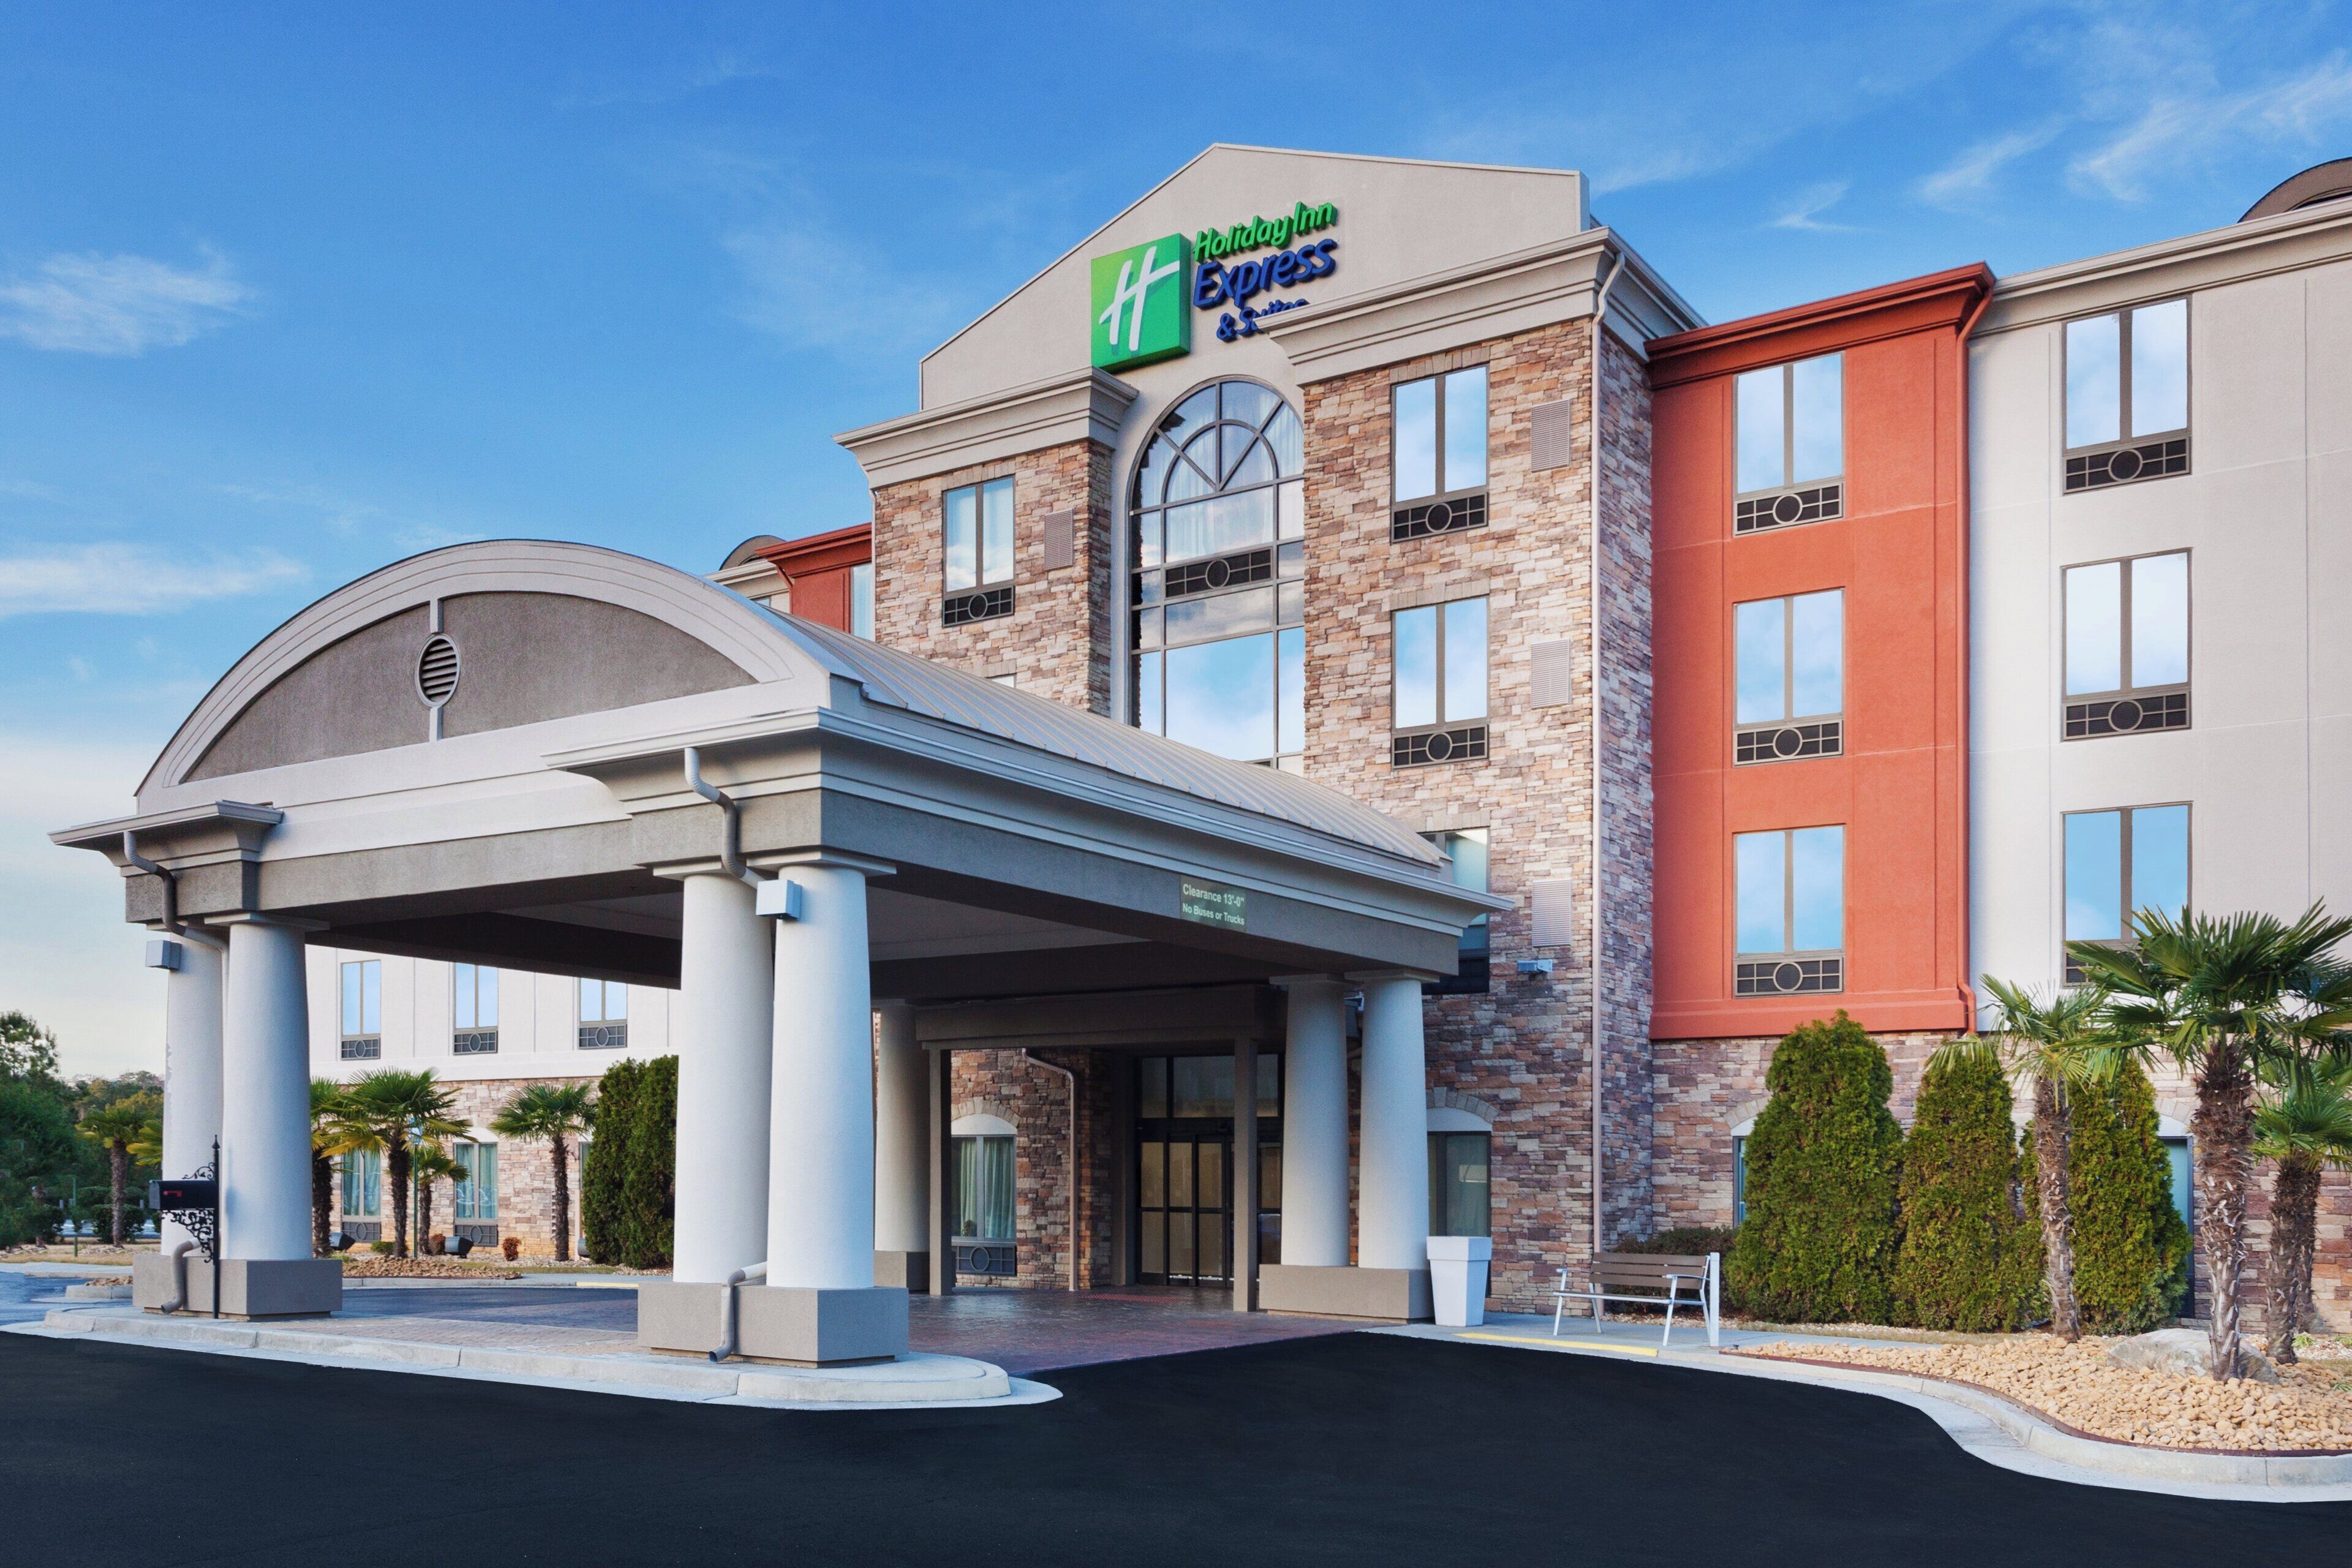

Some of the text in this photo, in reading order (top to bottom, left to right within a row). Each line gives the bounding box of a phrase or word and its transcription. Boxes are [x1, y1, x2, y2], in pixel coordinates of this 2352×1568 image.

[1194, 202, 1338, 263] Holiday Inn
[1193, 238, 1338, 311] Express
[1216, 313, 1237, 342] &
[1183, 884, 1245, 907] Clearance 13'-0"
[1183, 903, 1193, 913] No
[1194, 905, 1214, 918] Buses
[1224, 912, 1245, 925] Trucks
